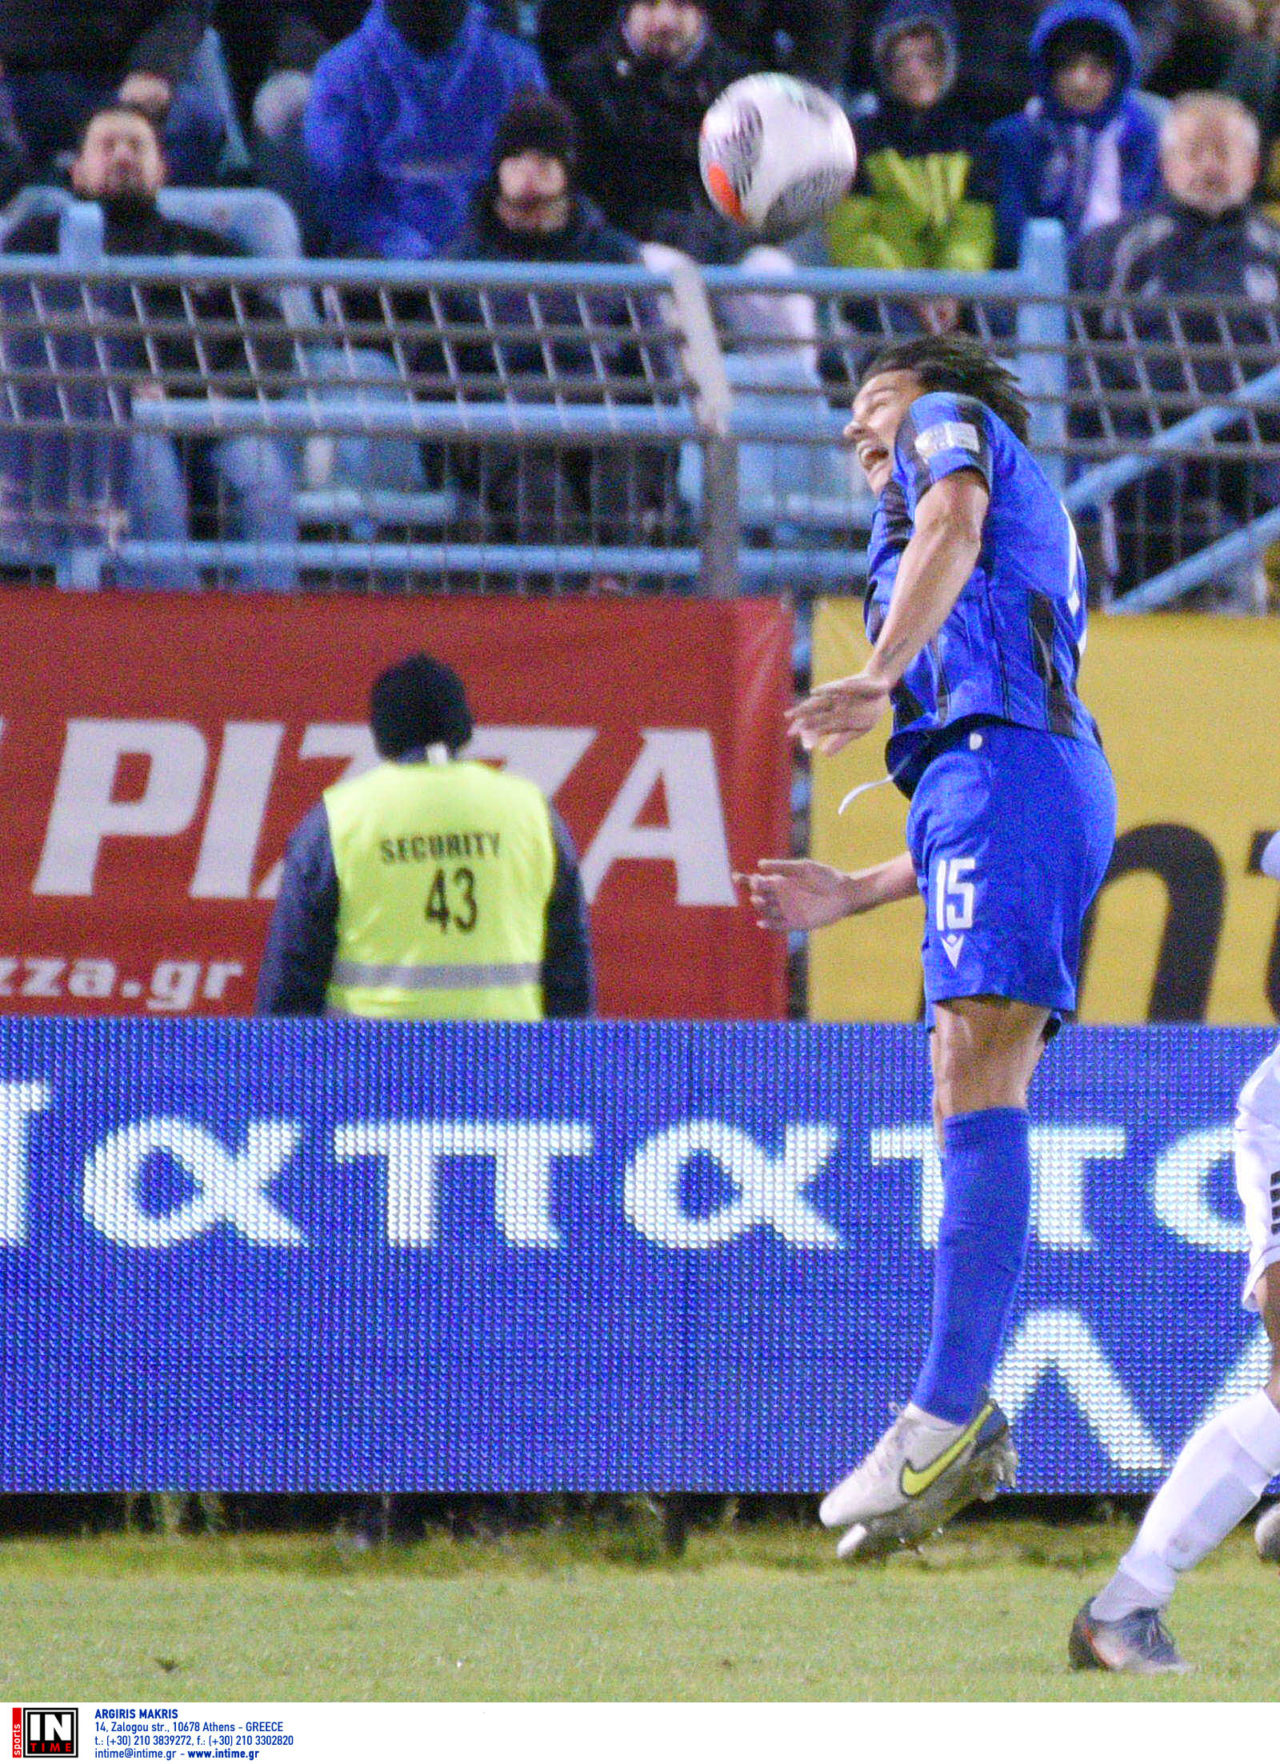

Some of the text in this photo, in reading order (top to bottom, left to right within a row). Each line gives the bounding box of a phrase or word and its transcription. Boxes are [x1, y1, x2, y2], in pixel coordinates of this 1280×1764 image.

[380, 832, 500, 864] SECURITY
[424, 867, 477, 934] 43
[936, 857, 976, 931] 15
